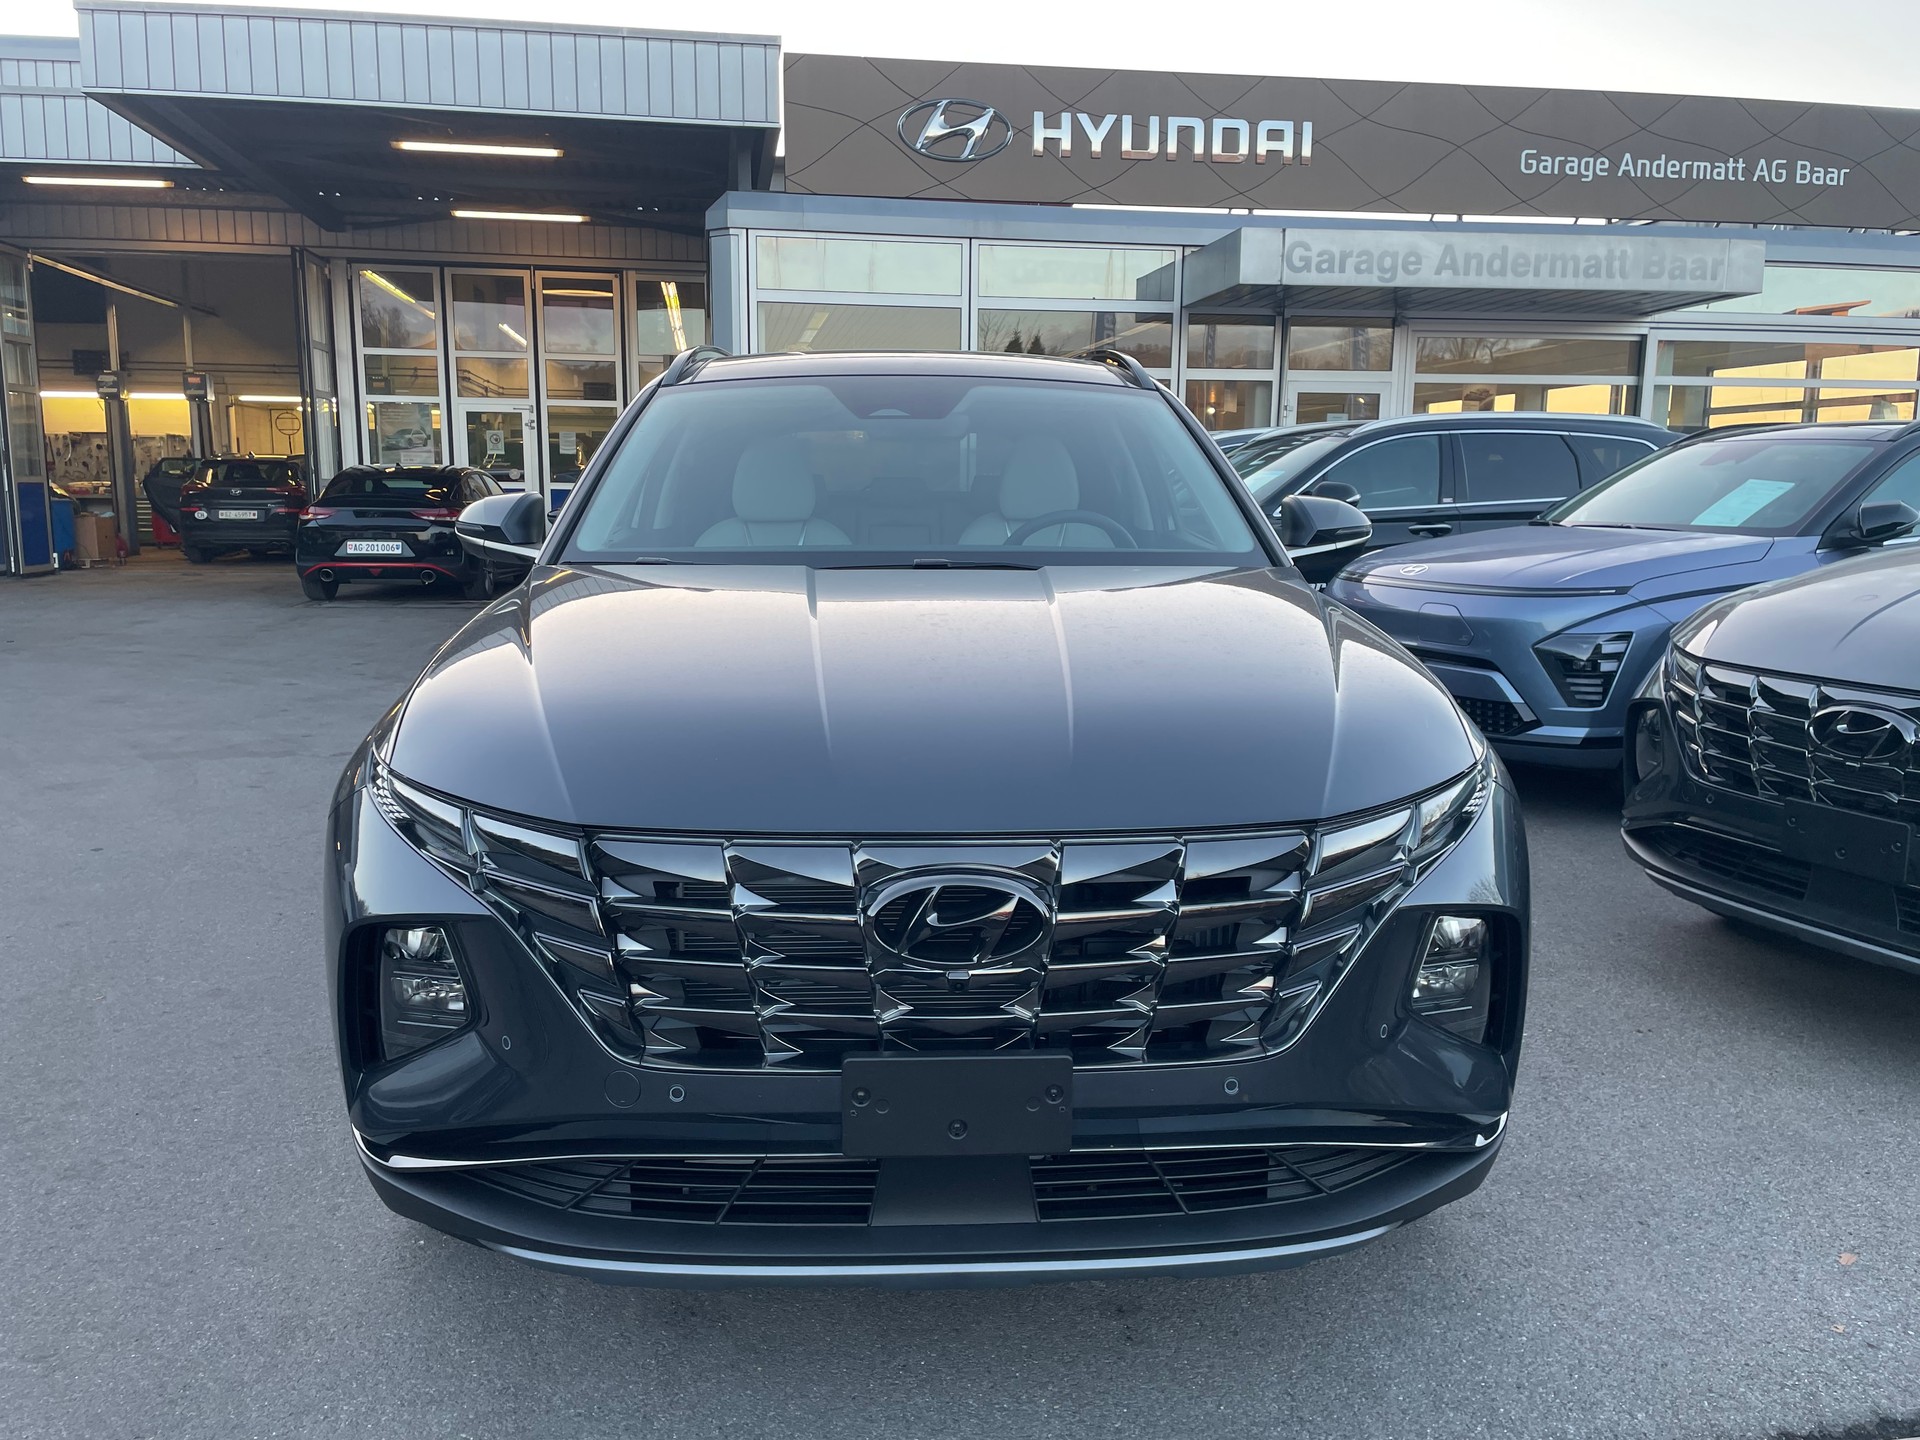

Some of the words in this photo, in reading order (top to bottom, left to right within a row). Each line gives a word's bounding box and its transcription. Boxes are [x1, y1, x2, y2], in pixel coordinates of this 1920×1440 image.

[1032, 111, 1312, 166] HYUNDAI
[1520, 150, 1609, 182] Garage
[1617, 153, 1746, 181] Andermatt
[1753, 158, 1787, 182] AG
[1795, 160, 1850, 186] Baar
[1285, 241, 1422, 283] Garage
[1434, 245, 1629, 280] Andermatt
[1642, 251, 1725, 281] Baar
